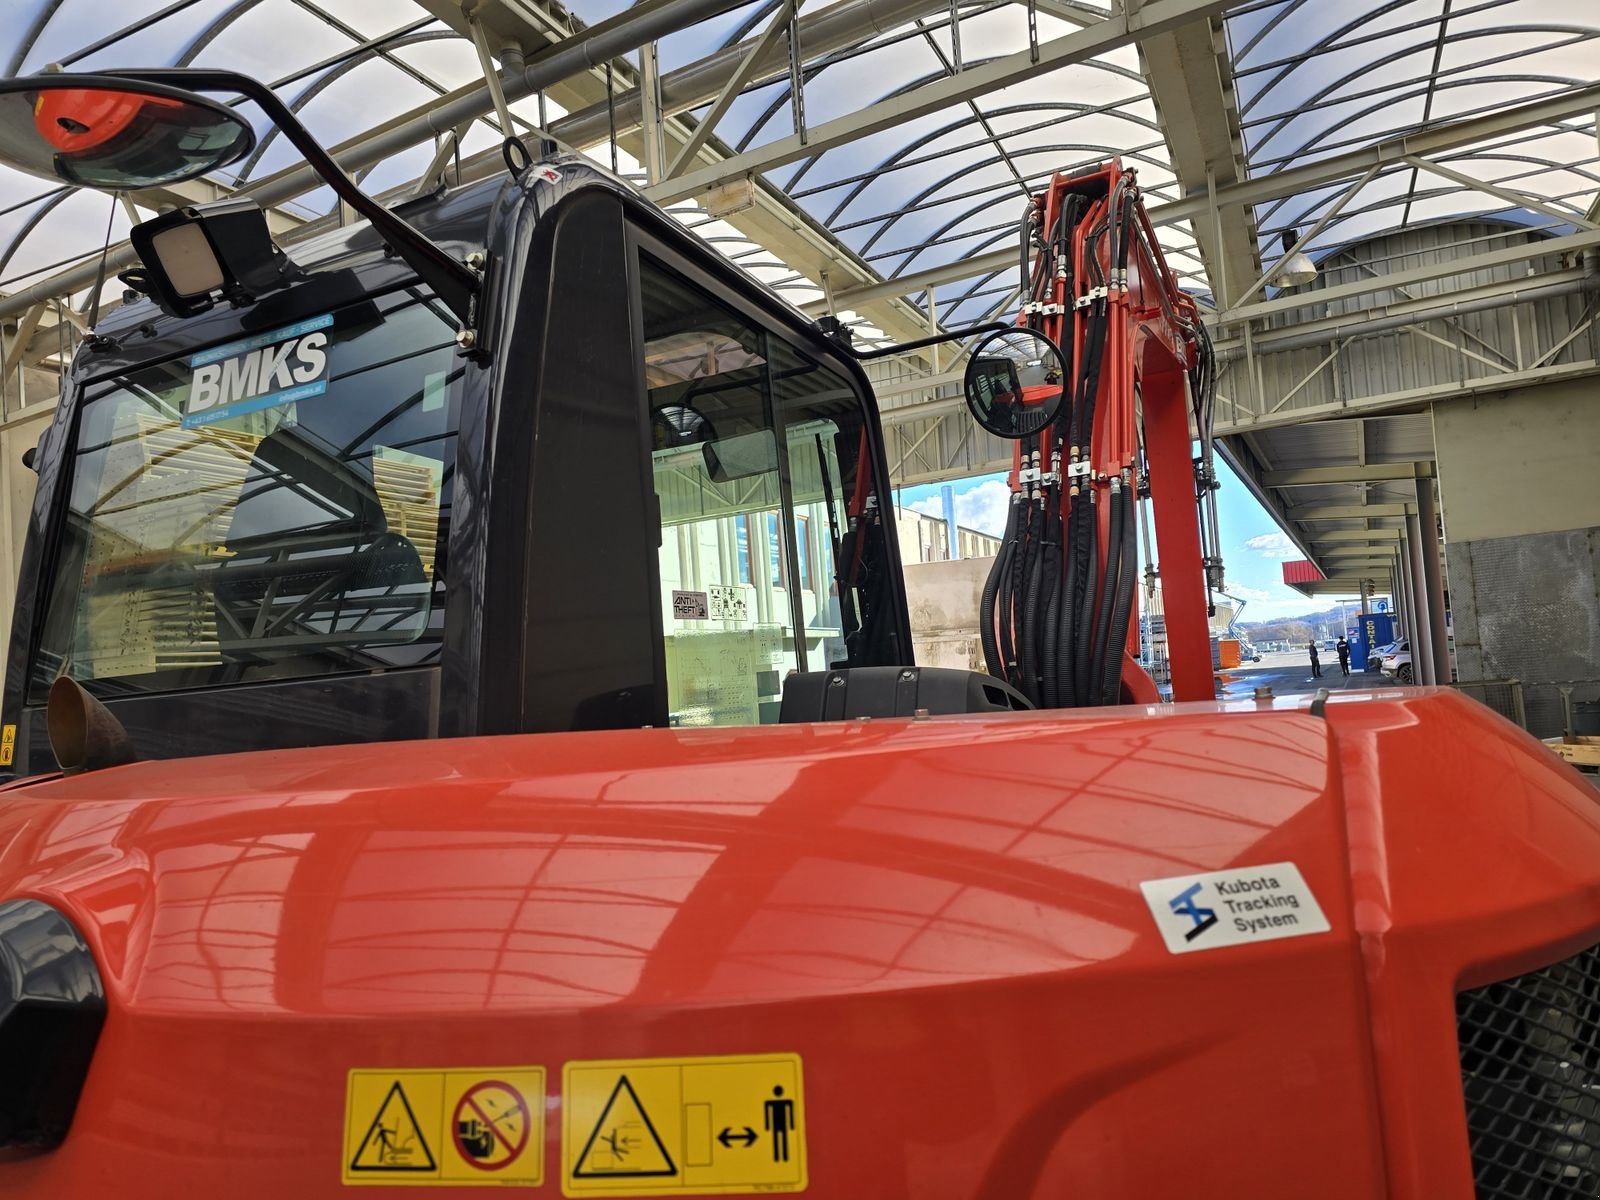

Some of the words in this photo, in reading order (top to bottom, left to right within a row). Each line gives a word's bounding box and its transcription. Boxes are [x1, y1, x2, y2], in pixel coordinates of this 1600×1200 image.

[300, 317, 330, 333] SERVICE
[188, 332, 327, 413] BMKS
[674, 596, 692, 605] ANTI
[674, 605, 696, 614] THEFT
[1214, 877, 1280, 896] Kubota
[1223, 894, 1300, 914] Tracking
[1234, 912, 1299, 933] System
